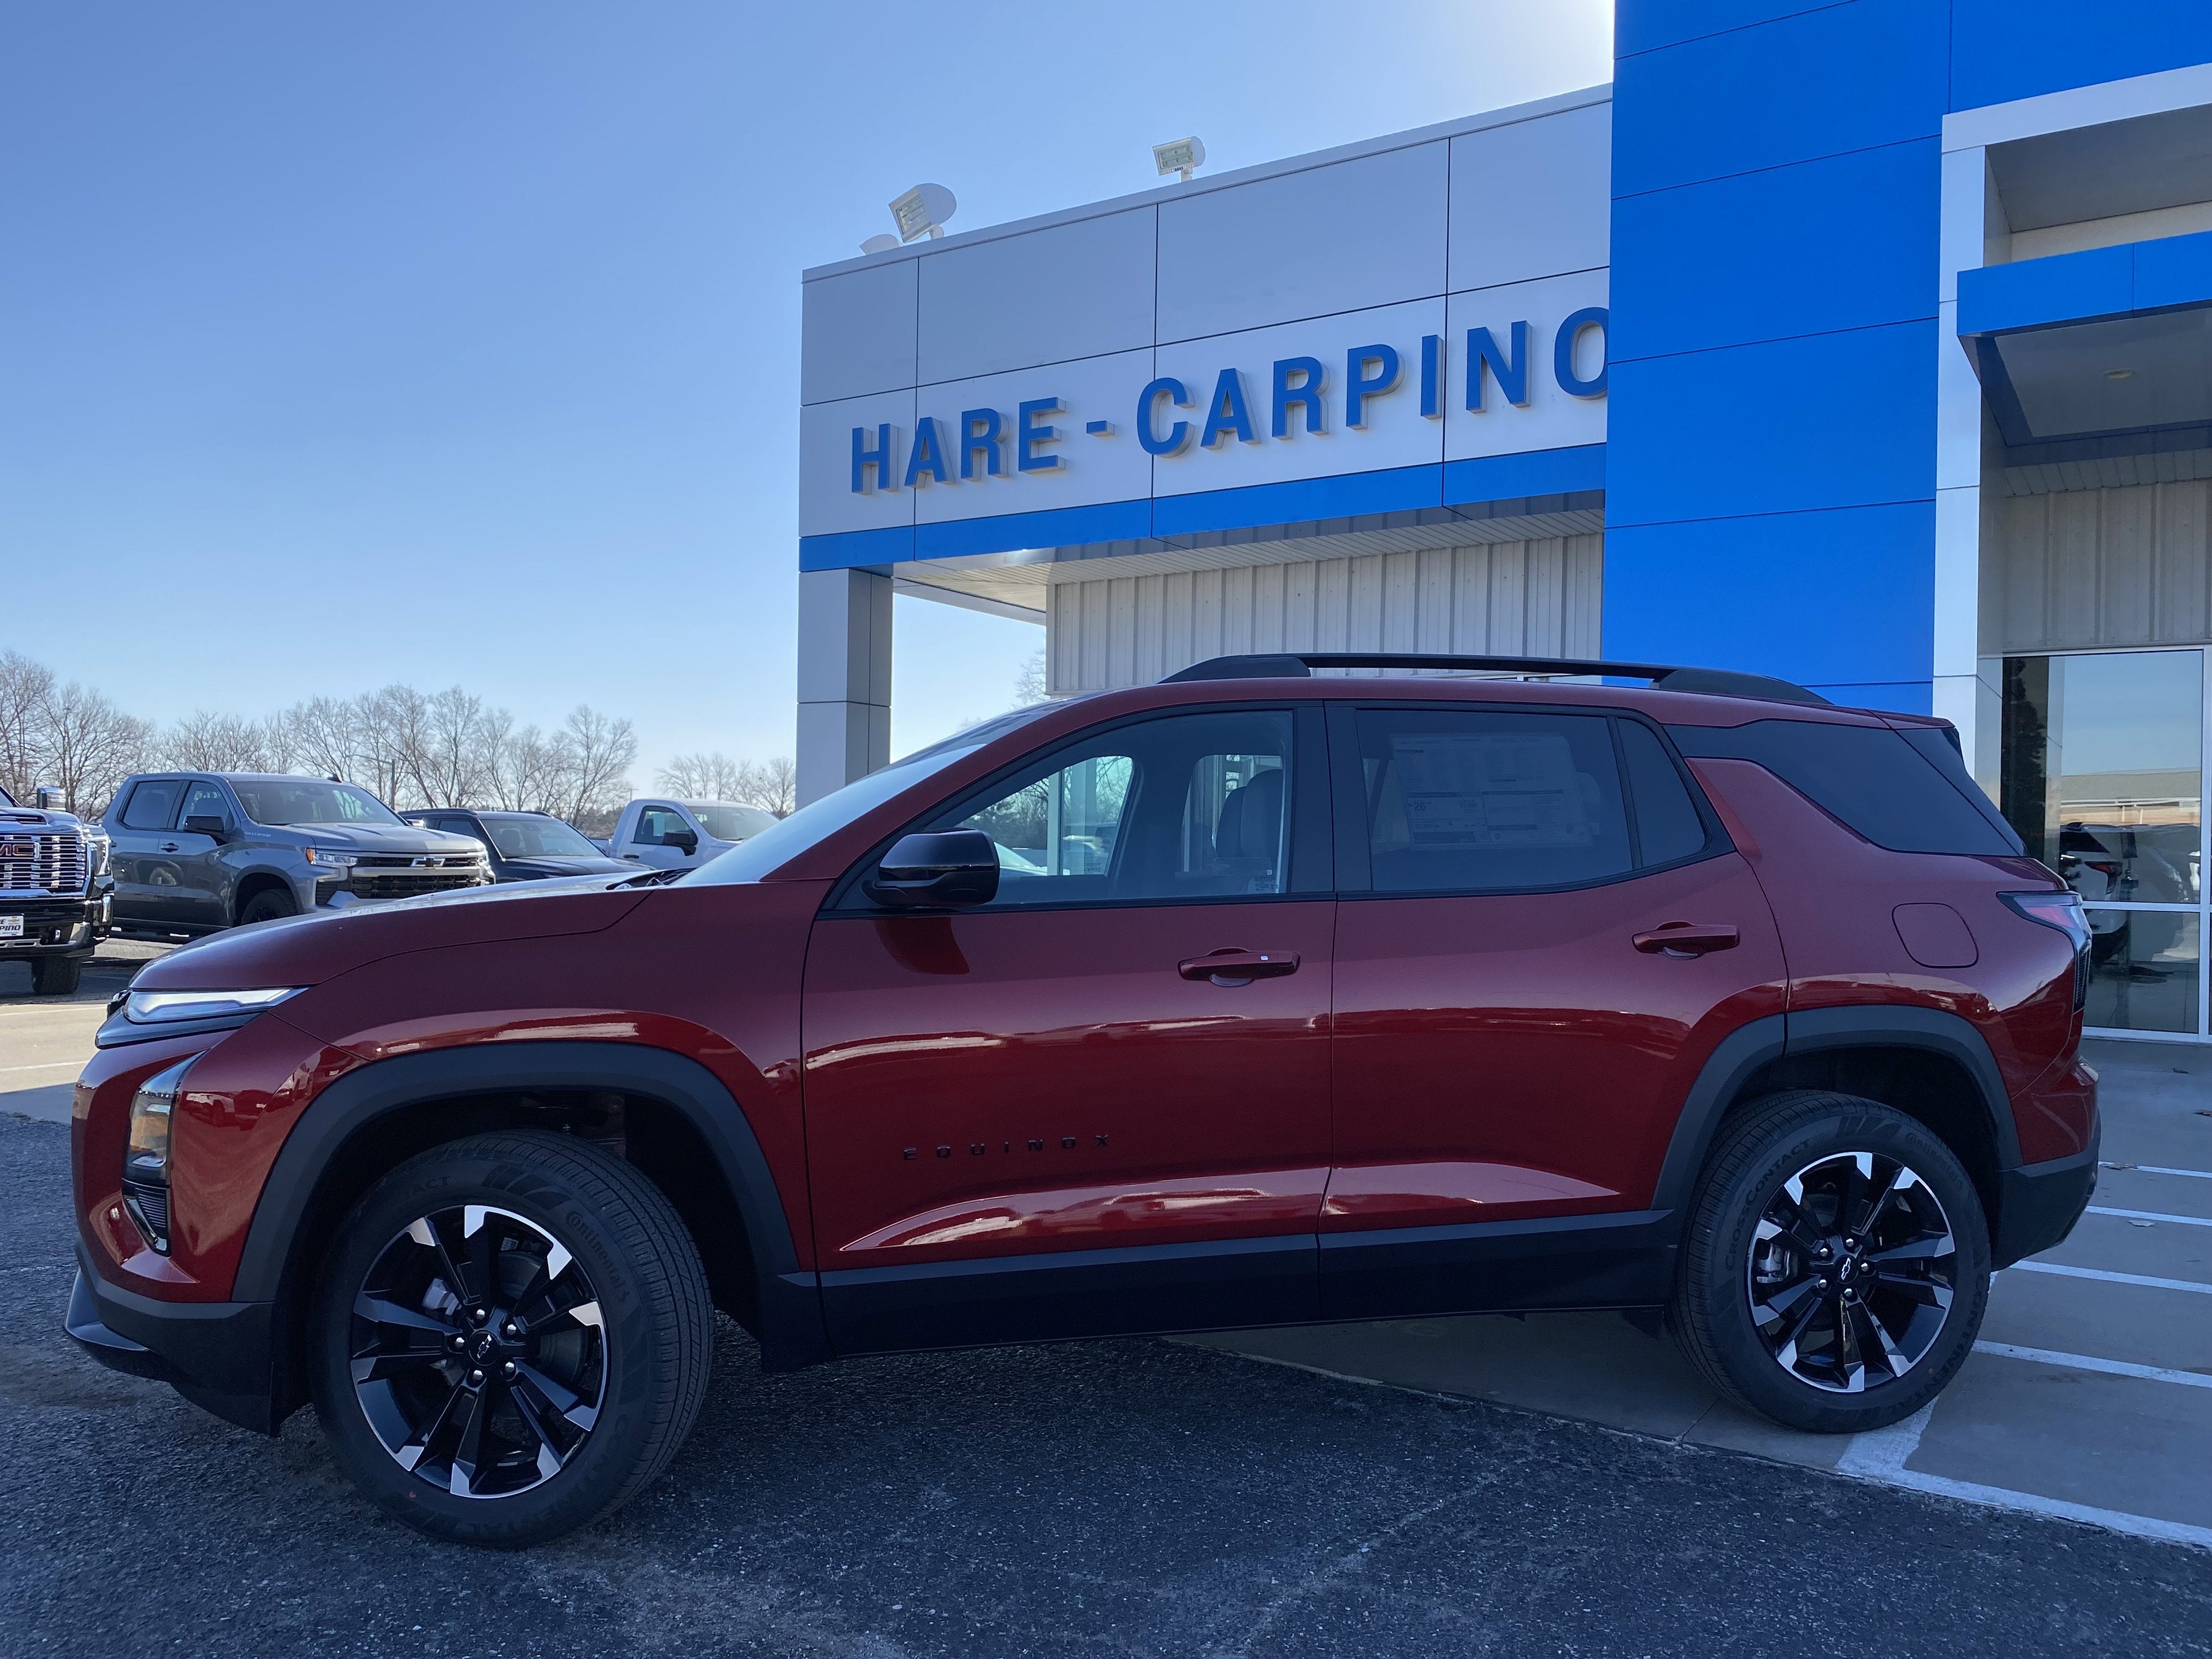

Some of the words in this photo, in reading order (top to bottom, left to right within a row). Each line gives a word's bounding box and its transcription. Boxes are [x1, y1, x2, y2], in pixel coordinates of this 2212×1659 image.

[851, 396, 1067, 495] HARE
[1136, 307, 1609, 459] CARPINO
[903, 1133, 1109, 1160] EQUINOX
[566, 1210, 627, 1289] Continental
